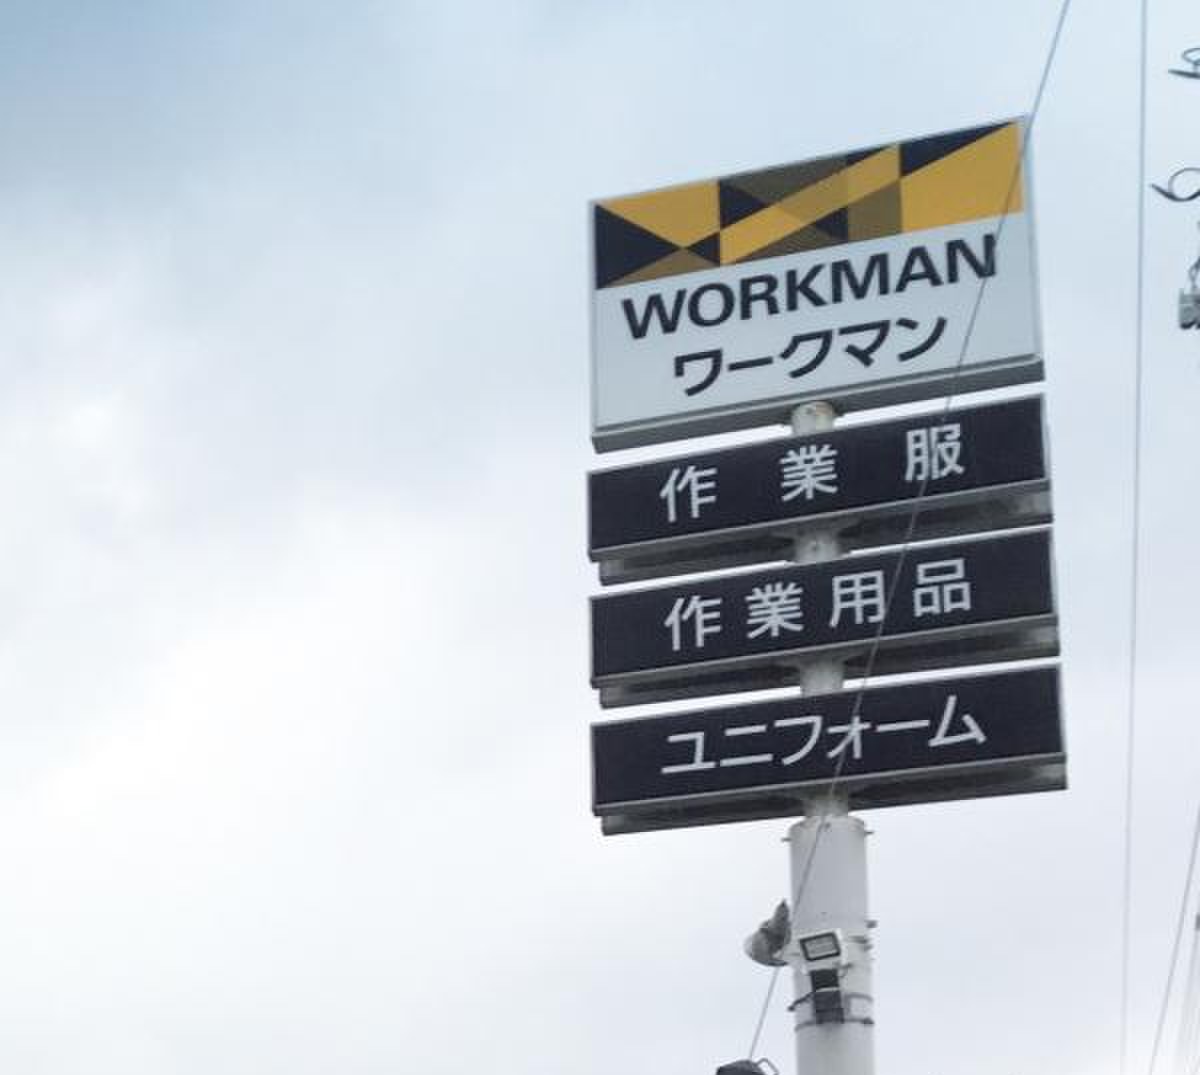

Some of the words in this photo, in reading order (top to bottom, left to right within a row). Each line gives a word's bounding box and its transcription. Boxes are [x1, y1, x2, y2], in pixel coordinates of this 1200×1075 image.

[621, 233, 998, 339] WORKMAN
[674, 317, 947, 396] ワークマン
[660, 423, 965, 522] 作業服
[664, 560, 971, 650] 作業用品
[661, 695, 986, 774] ユニフォーム
